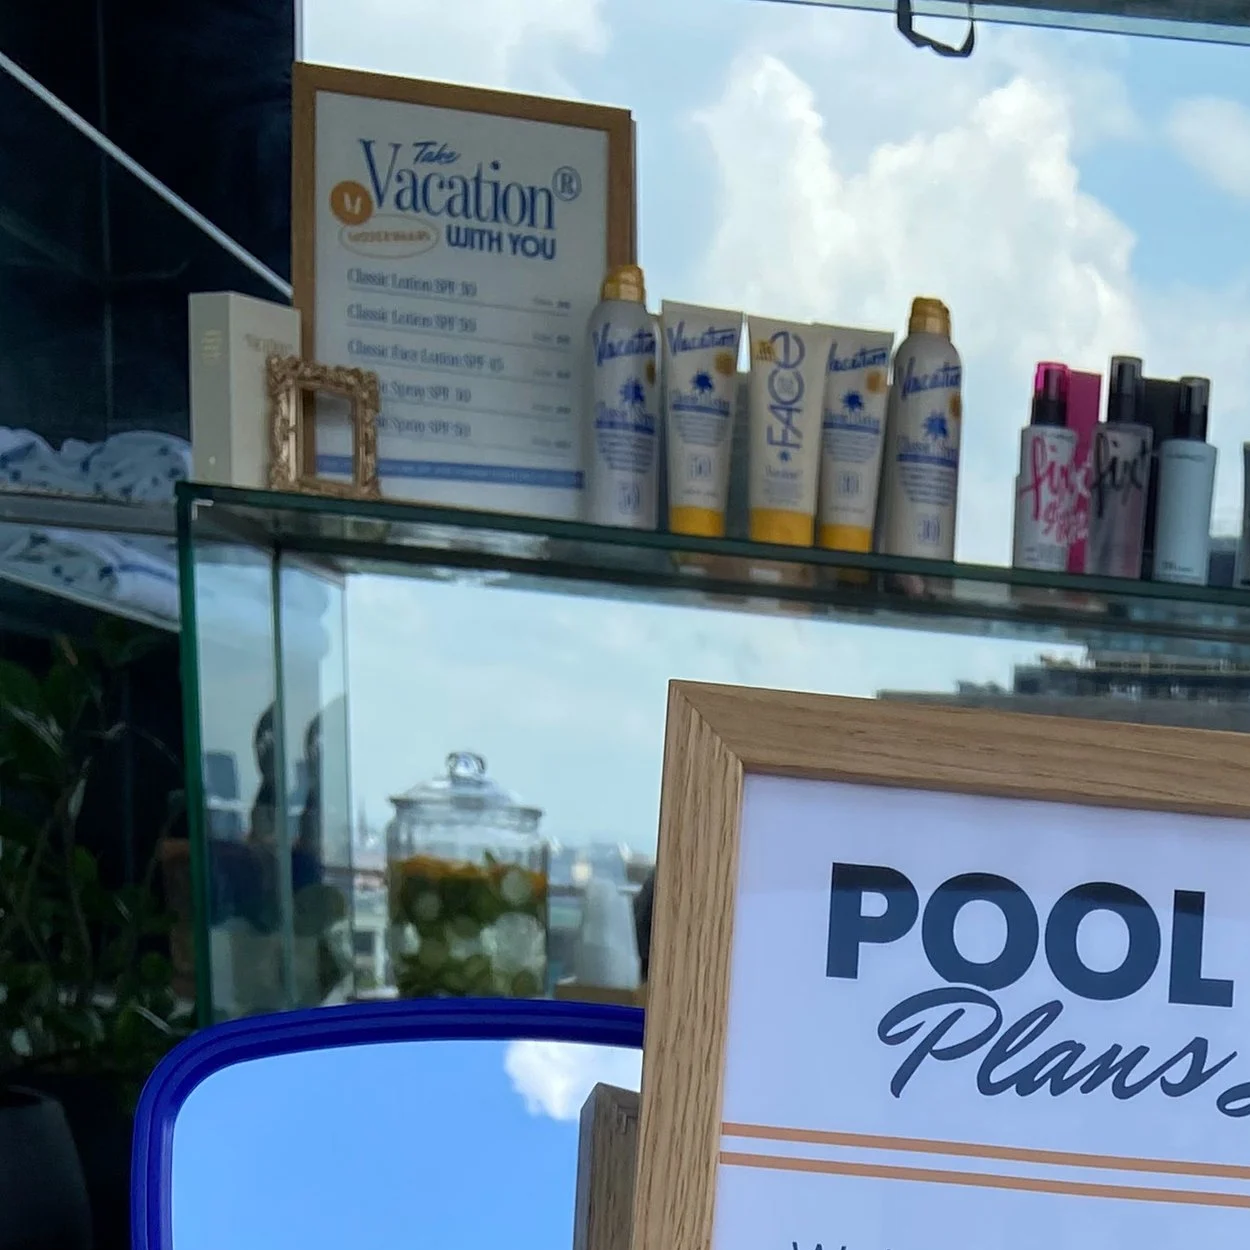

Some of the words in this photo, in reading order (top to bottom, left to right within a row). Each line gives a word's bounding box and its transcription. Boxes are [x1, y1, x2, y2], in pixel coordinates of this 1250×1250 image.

[446, 224, 503, 254] WITH
[508, 233, 557, 261] YOU
[824, 861, 1234, 1010] POOL
[876, 985, 1238, 1100] Plans
